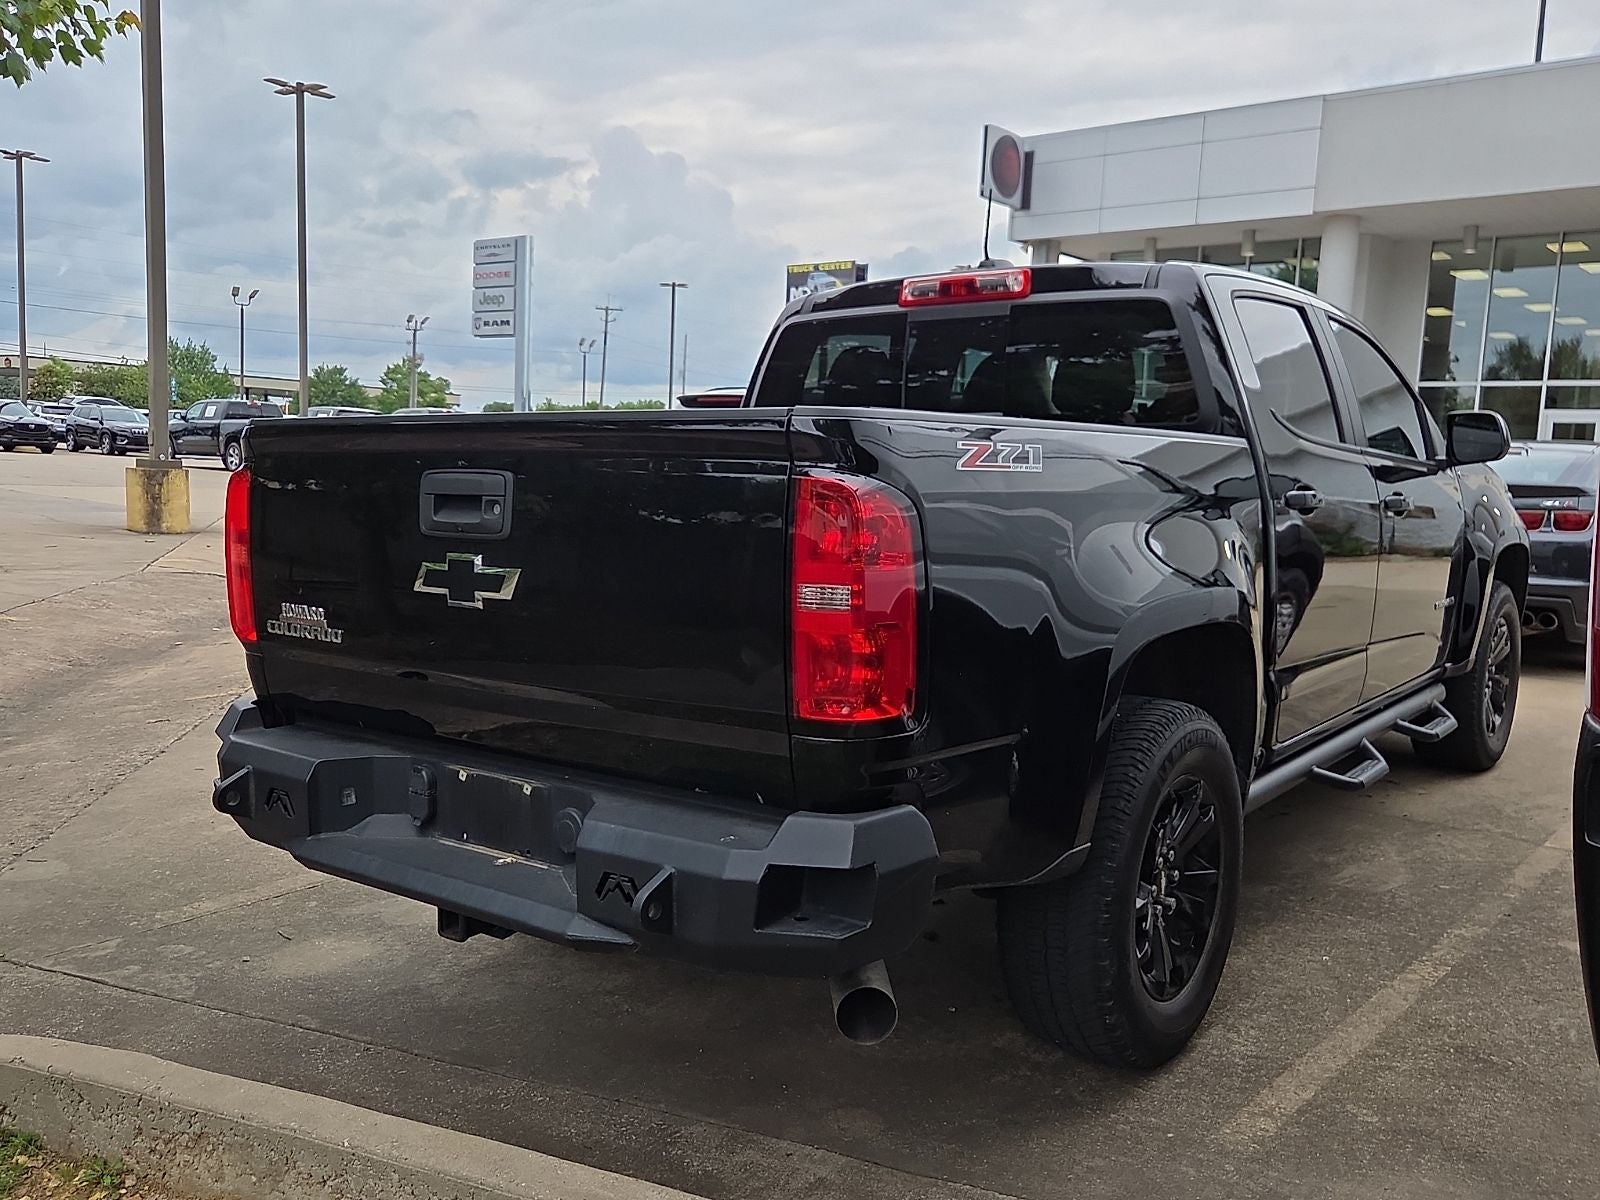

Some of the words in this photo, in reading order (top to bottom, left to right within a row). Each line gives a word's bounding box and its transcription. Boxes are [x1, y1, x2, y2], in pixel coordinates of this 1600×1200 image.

[818, 261, 852, 271] CENTER
[475, 271, 511, 280] DODGE
[479, 291, 504, 307] Jeep
[957, 441, 1042, 471] Z71
[266, 619, 342, 643] COLORADO
